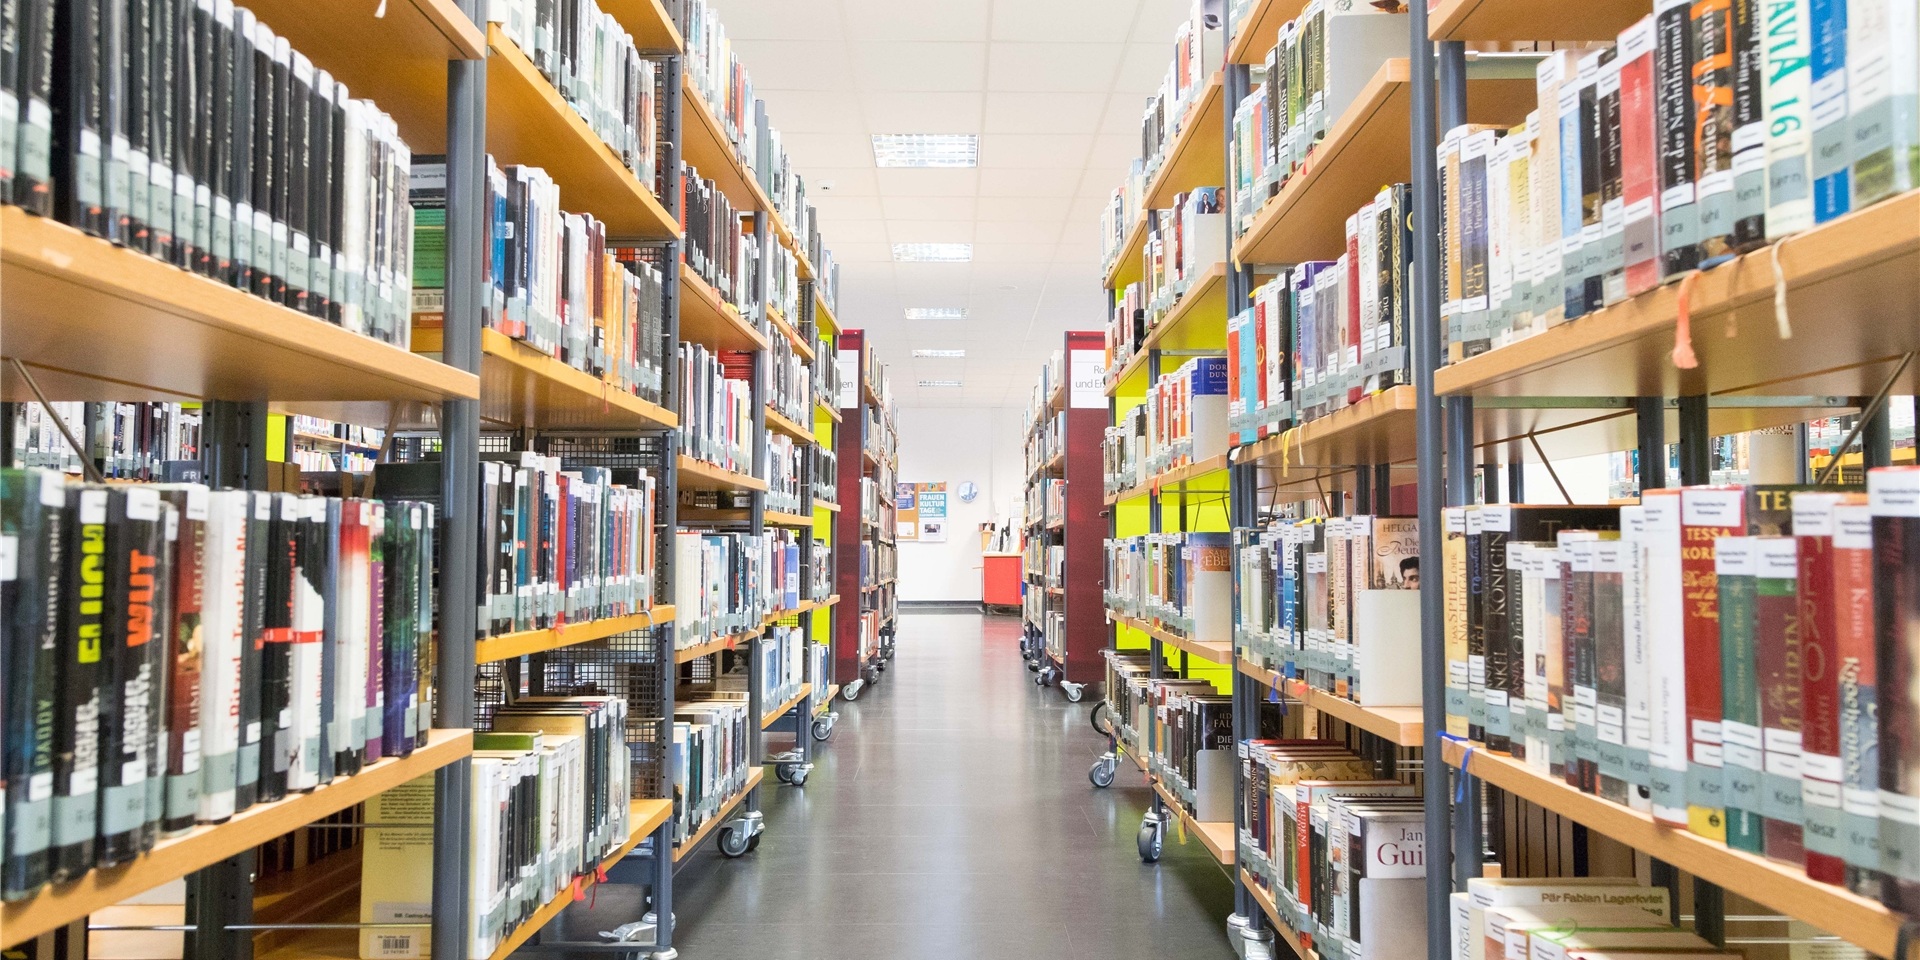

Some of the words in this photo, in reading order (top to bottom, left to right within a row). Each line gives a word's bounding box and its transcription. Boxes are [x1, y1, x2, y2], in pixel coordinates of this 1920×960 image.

[1699, 4, 1716, 109] Kehlmann
[1666, 12, 1684, 129] Nachthimmels
[1770, 97, 1801, 137] 16
[1669, 132, 1684, 157] des
[1674, 162, 1686, 184] ost
[1462, 180, 1473, 215] dunkle
[1463, 218, 1474, 235] Die
[1208, 363, 1228, 371] DOR
[841, 381, 853, 389] en
[1075, 379, 1093, 389] und
[1382, 523, 1418, 533] HELGA
[1685, 527, 1732, 542] TESSA
[375, 565, 385, 652] ROBERTS
[411, 564, 419, 632] ROBERTS
[1448, 575, 1459, 623] SPIEL
[1634, 619, 1642, 632] die
[411, 638, 419, 683] NORA
[34, 699, 55, 767] PADDY
[1300, 802, 1308, 849] MUDENA
[1400, 828, 1424, 842] Jan
[1376, 842, 1427, 867] Gui
[1541, 892, 1562, 904] Pär
[1563, 892, 1600, 904] Fabian
[1602, 892, 1664, 905] Lagerkvist
